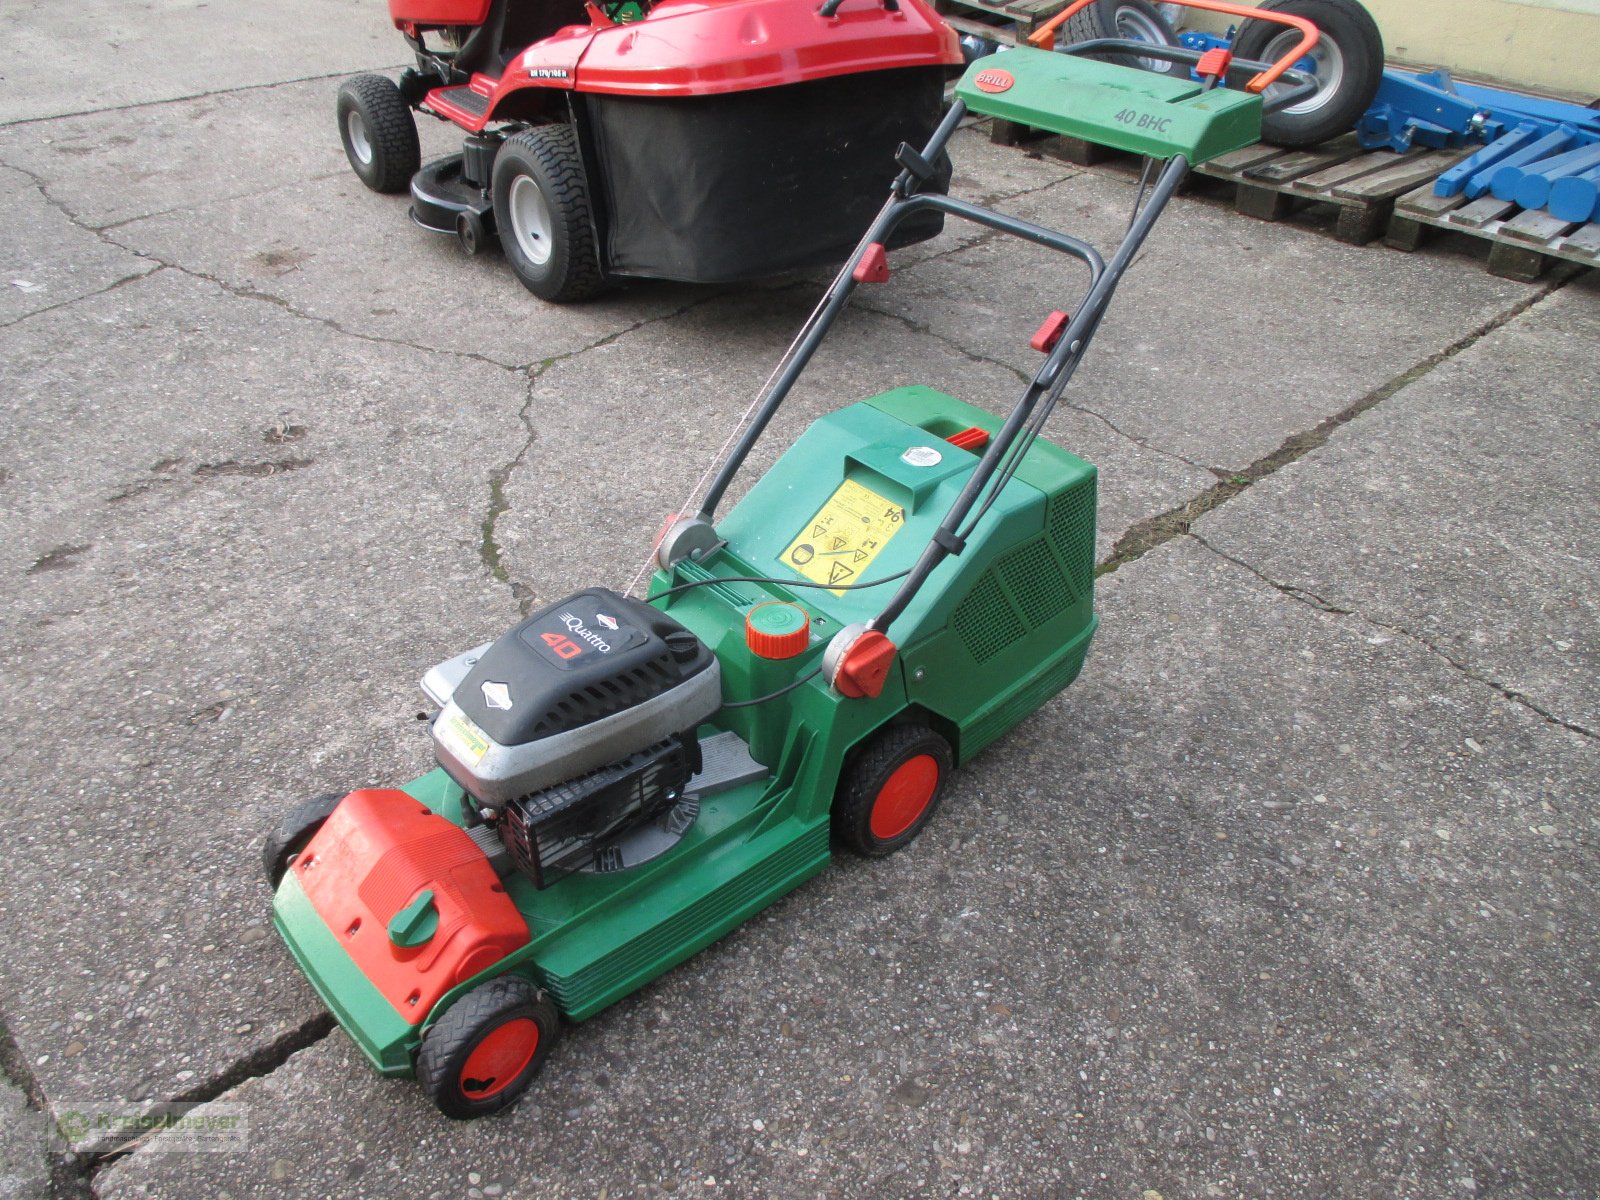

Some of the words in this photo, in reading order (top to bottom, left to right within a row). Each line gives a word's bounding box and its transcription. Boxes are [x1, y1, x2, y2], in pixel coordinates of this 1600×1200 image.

[977, 73, 1008, 88] BRILL
[1113, 109, 1136, 124] 40
[1136, 113, 1172, 132] BHC
[540, 632, 582, 659] 40
[563, 615, 611, 652] Quattro
